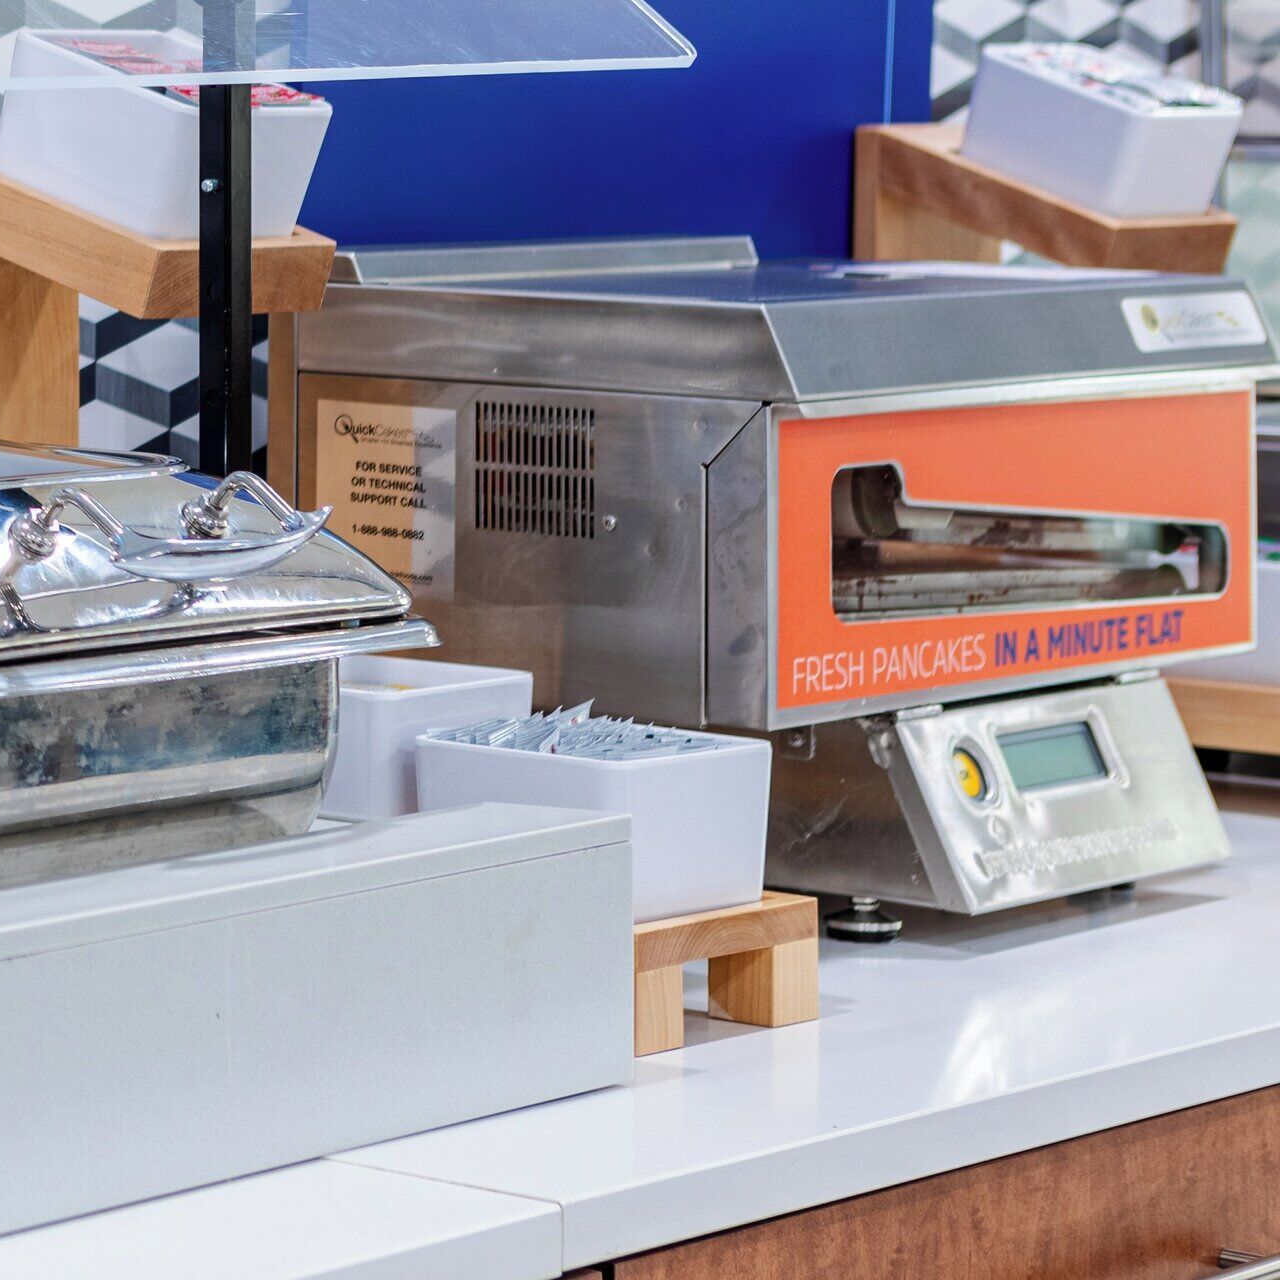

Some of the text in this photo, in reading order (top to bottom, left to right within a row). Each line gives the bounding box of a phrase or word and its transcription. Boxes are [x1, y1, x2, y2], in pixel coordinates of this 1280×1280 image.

[355, 461, 422, 477] FOR SERVICE
[351, 476, 426, 494] OR TECHNICAL
[350, 492, 428, 509] SUPPORT CALL
[791, 609, 1184, 696] FRESH PANCAKES IN A MINUTE FLAT
